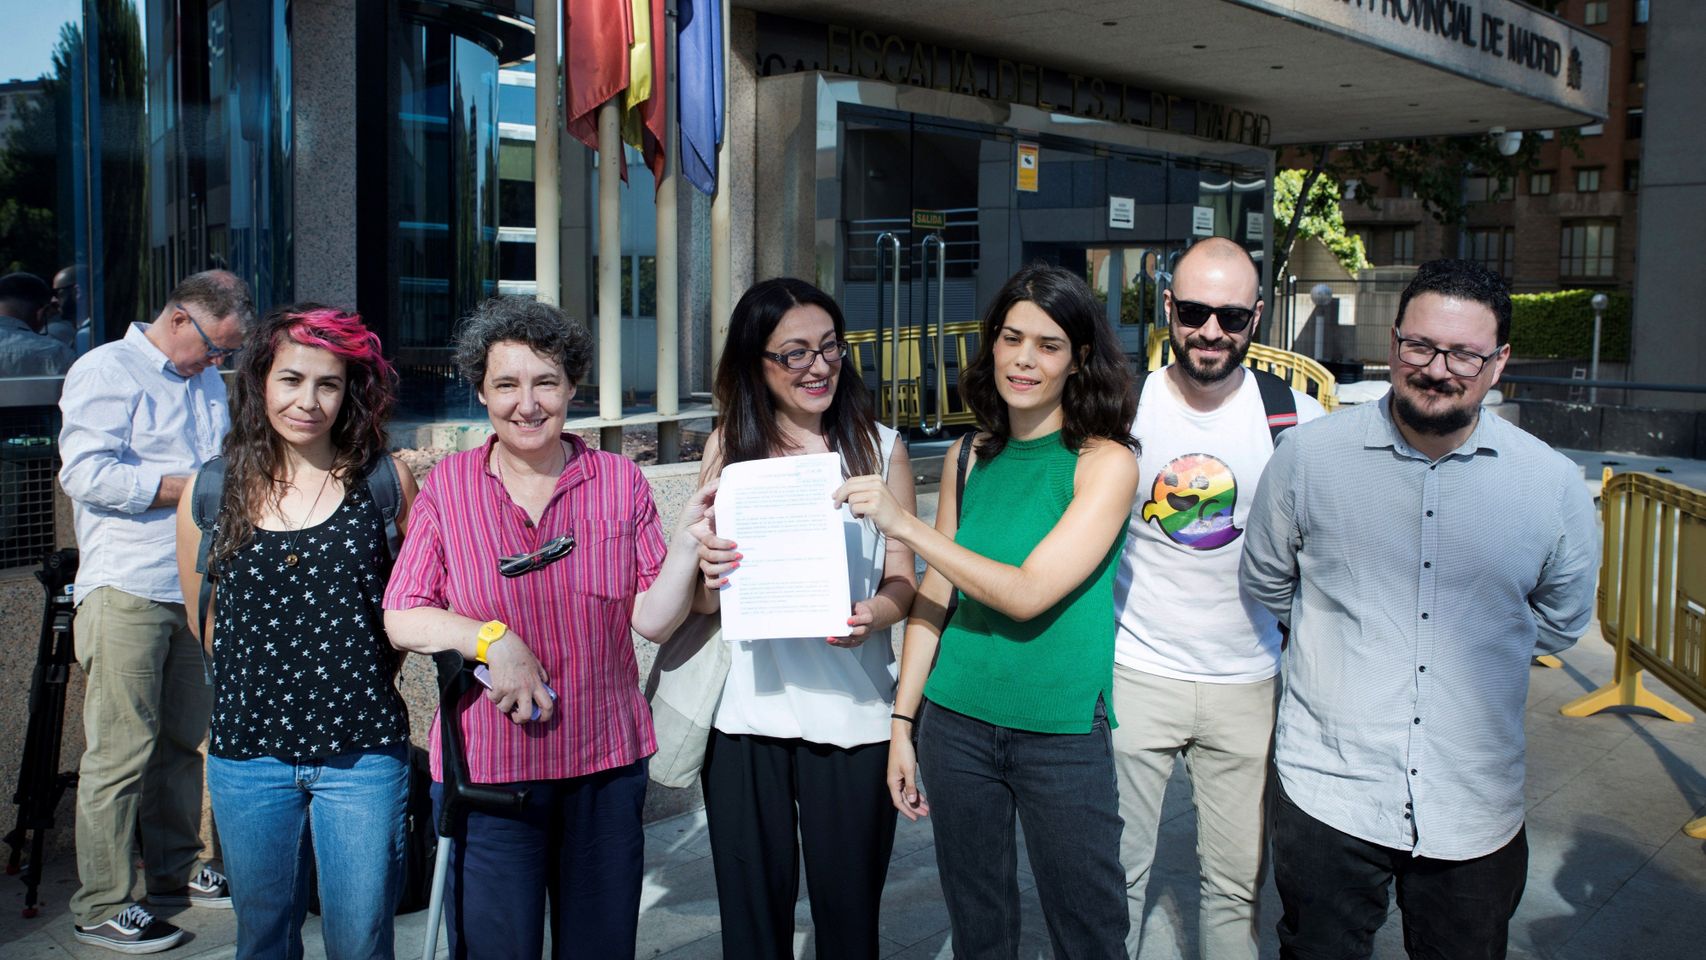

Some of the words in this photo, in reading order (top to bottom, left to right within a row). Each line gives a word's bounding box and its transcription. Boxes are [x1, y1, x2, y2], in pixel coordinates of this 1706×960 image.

[1368, 0, 1477, 47] OVINCIAL
[1481, 12, 1504, 57] DE
[1507, 23, 1561, 77] MADRID
[997, 57, 1056, 110] DEL
[1150, 90, 1184, 131] DE
[1195, 100, 1272, 146] MADRID
[916, 213, 943, 225] SALIDA
